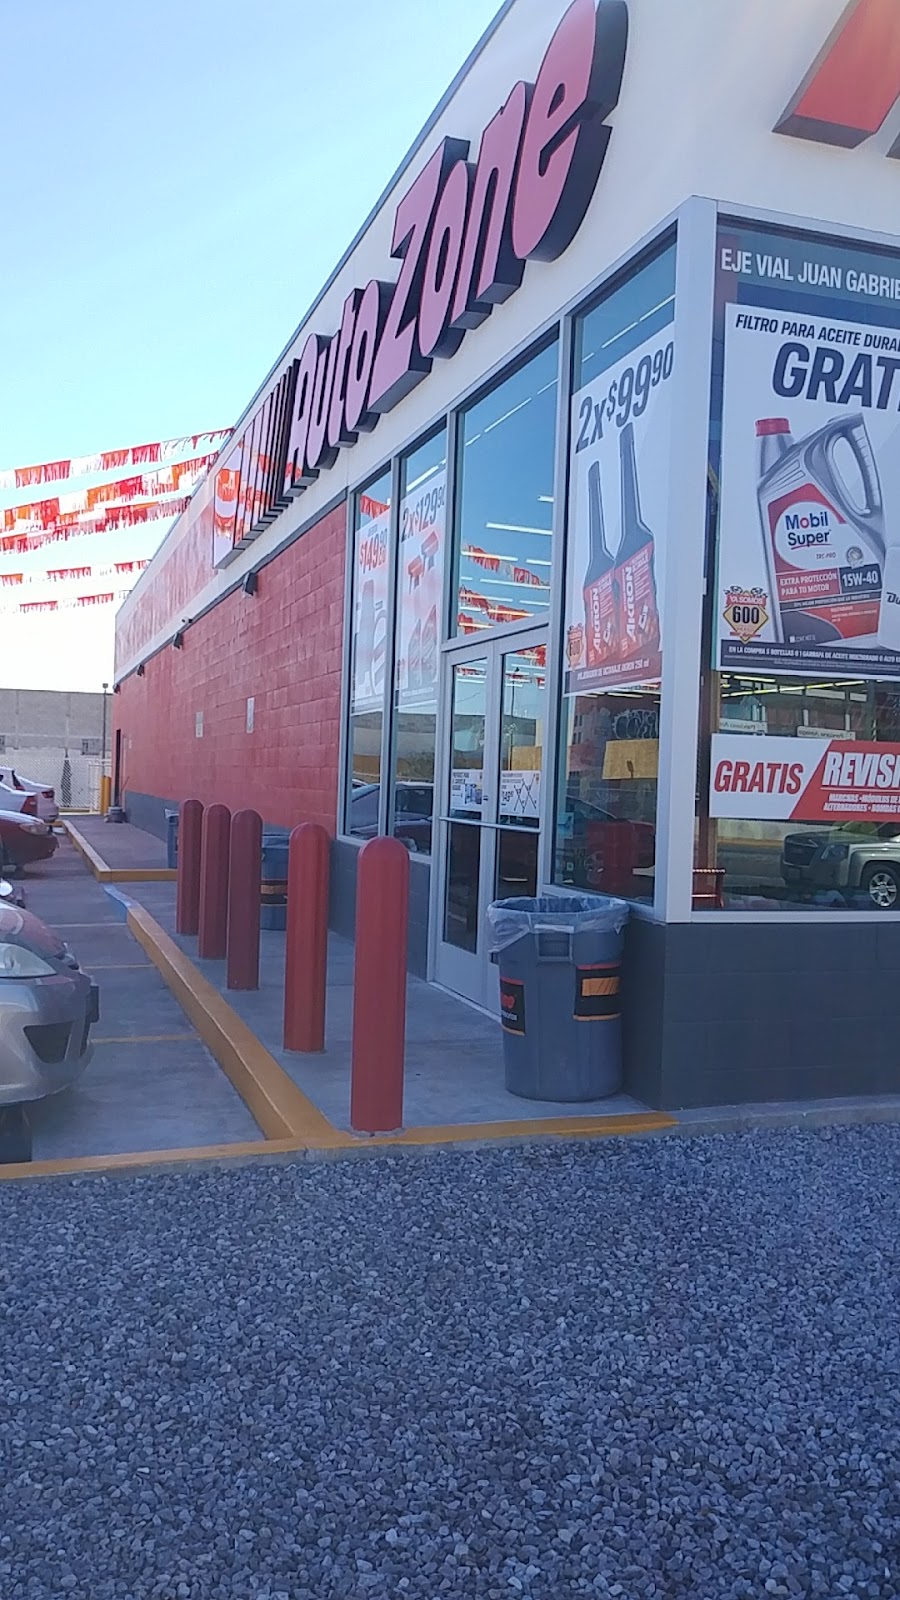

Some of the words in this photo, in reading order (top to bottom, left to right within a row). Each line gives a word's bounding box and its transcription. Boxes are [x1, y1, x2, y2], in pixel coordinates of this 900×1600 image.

[284, 0, 629, 497] AutoZone
[721, 248, 752, 274] EJE
[756, 253, 794, 281] VIAL
[798, 262, 842, 289] JUAN
[735, 313, 778, 333] FILTRO
[781, 320, 815, 339] PARA
[818, 326, 862, 346] ACEITE
[863, 333, 900, 352] DURA
[772, 342, 900, 412] GRAT
[785, 511, 828, 530] Mobil
[787, 529, 830, 547] Super
[780, 577, 799, 587] EXTRA
[781, 586, 798, 596] PARA
[799, 585, 807, 594] TU
[808, 583, 830, 593] MOTOR
[842, 570, 878, 587] 15W-40
[592, 587, 601, 654] AKRON
[625, 566, 637, 643] AKRON
[732, 605, 760, 625] 600
[714, 760, 804, 794] GRATIS
